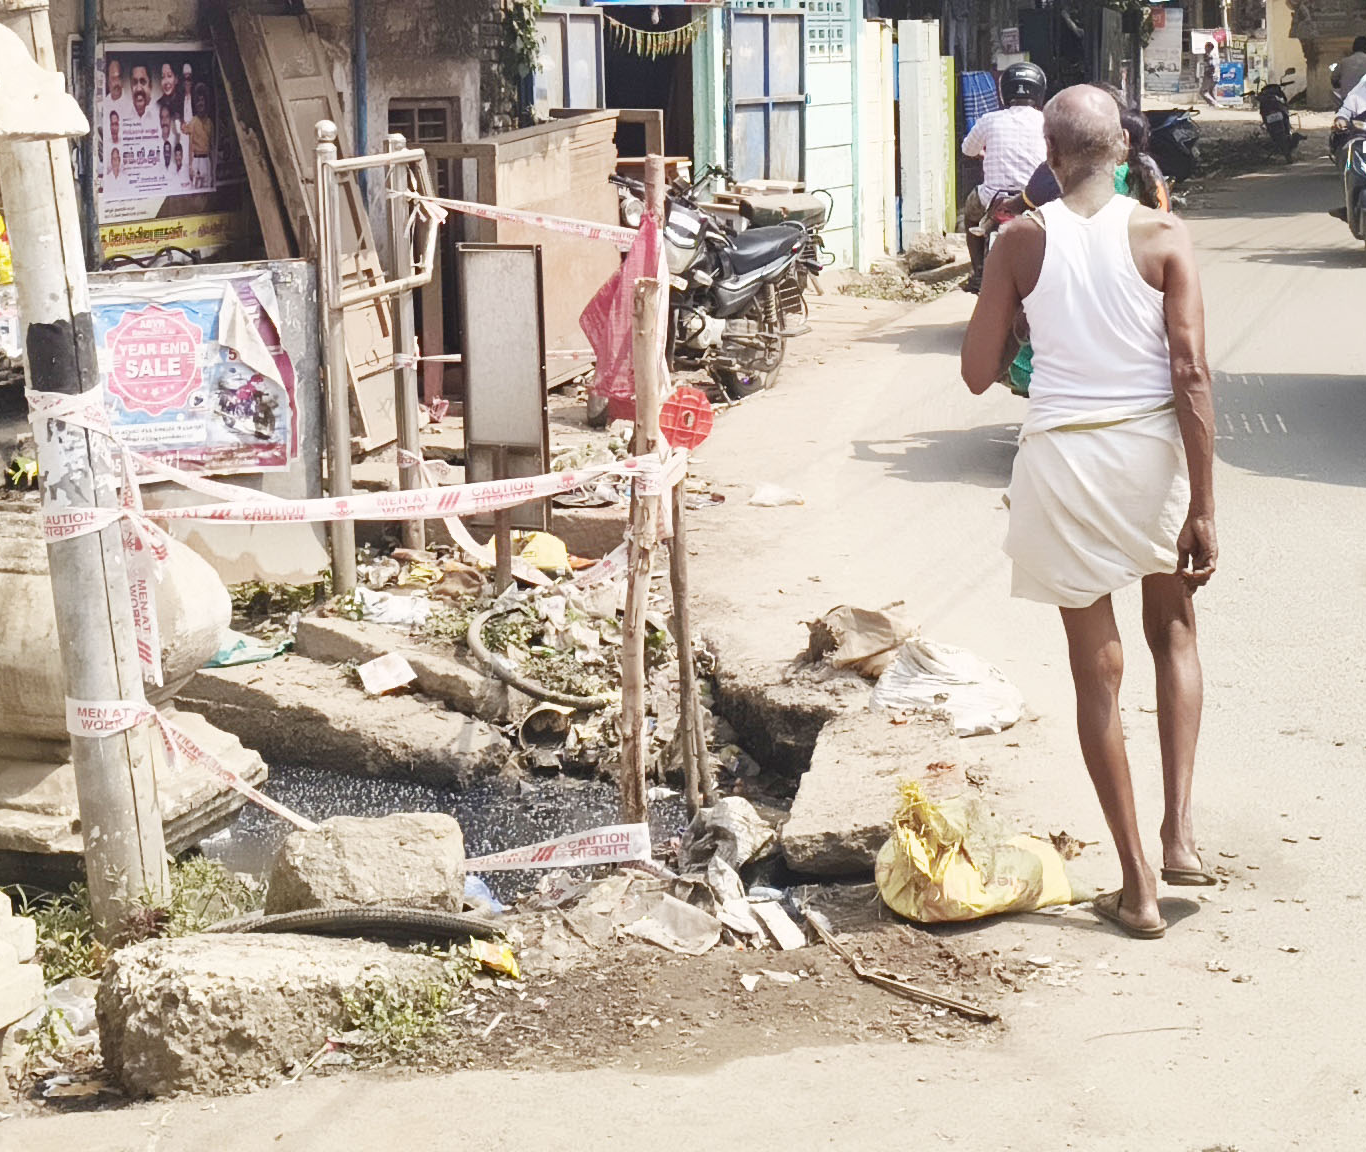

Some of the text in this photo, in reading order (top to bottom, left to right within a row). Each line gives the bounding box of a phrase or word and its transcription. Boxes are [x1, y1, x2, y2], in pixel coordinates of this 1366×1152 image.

[119, 341, 190, 356] YEAR END
[126, 358, 181, 379] SALE
[471, 480, 535, 497] CAUTION
[44, 511, 95, 525] AUTION
[77, 707, 131, 718] MEN AT
[568, 832, 630, 850] CAUTION
